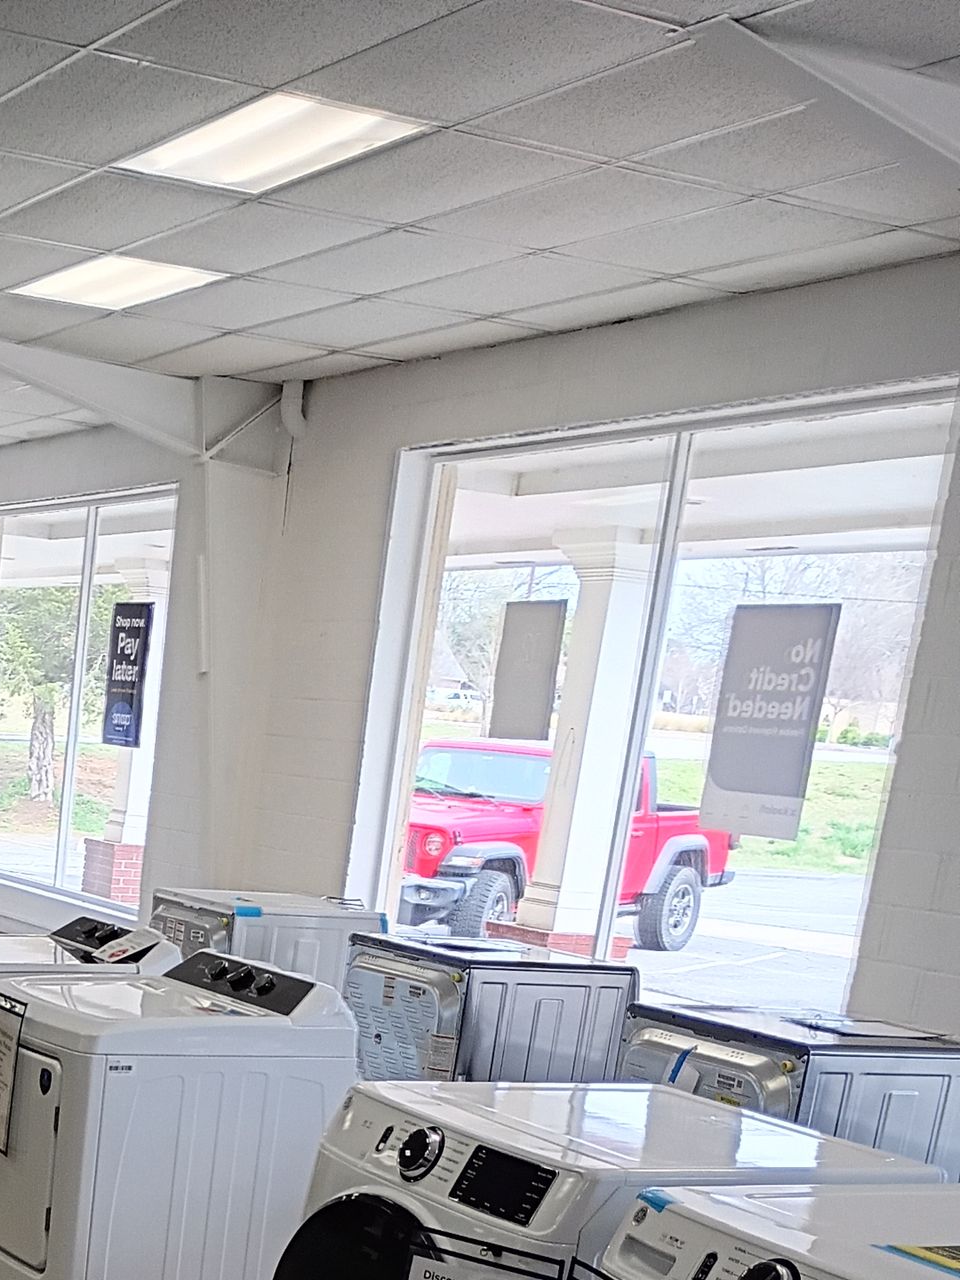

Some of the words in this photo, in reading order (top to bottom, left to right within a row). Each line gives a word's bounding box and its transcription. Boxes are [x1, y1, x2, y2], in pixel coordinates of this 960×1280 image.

[116, 616, 130, 629] Shop
[117, 633, 139, 660] Pay
[112, 660, 139, 682] later.
